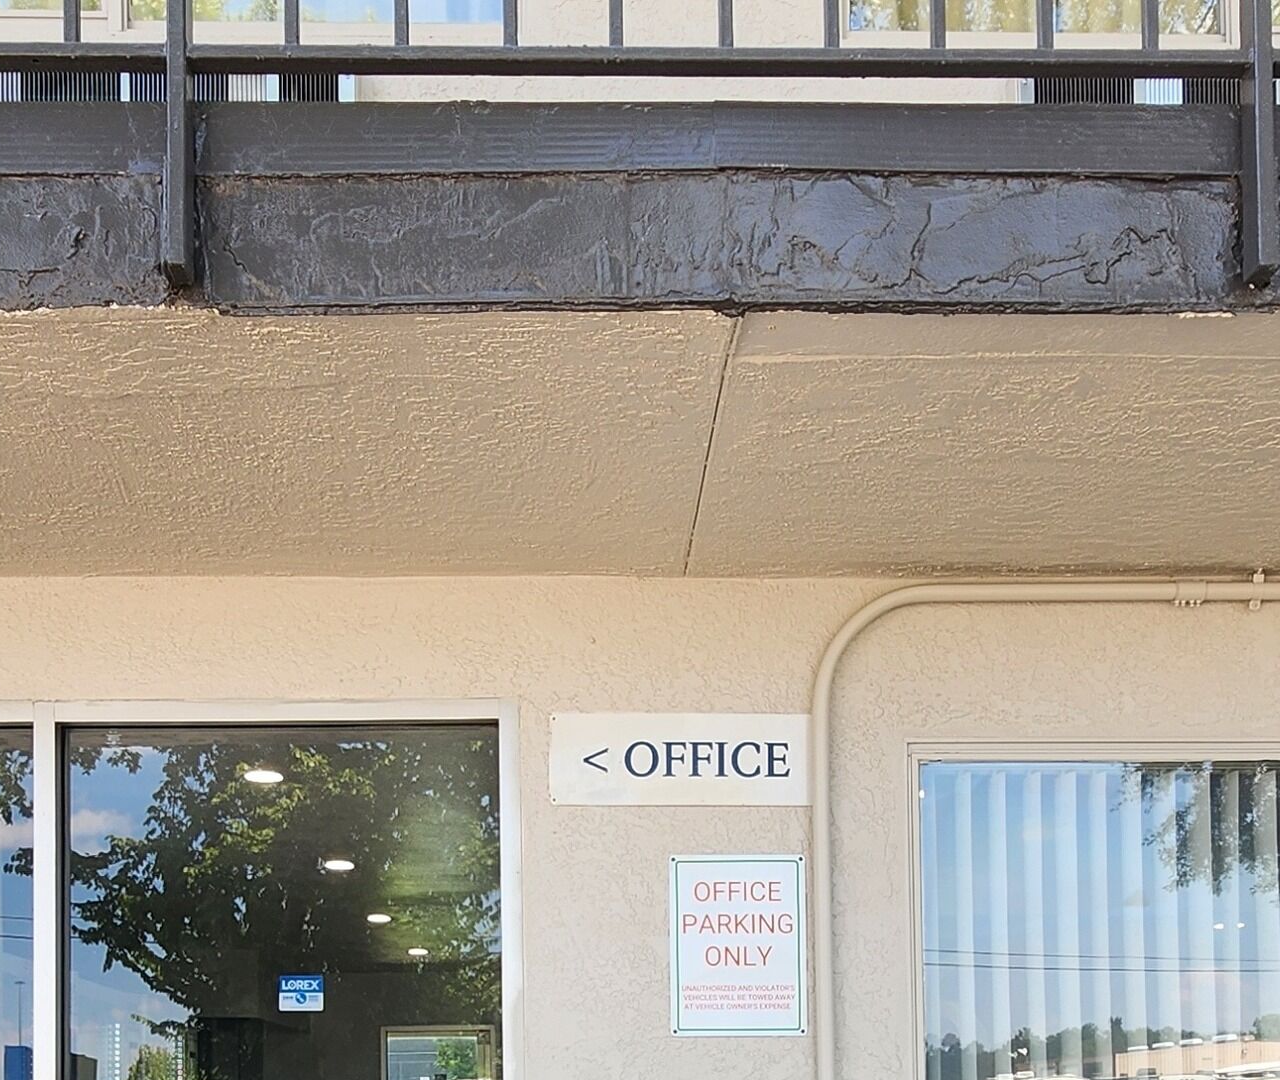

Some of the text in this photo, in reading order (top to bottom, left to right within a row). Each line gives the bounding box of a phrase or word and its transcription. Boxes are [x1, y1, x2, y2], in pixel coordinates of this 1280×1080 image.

[624, 741, 791, 778] OFFICE
[694, 881, 782, 902] OFFICE
[682, 913, 793, 934] PARKING
[705, 945, 772, 966] ONLY
[281, 980, 320, 990] LOREX
